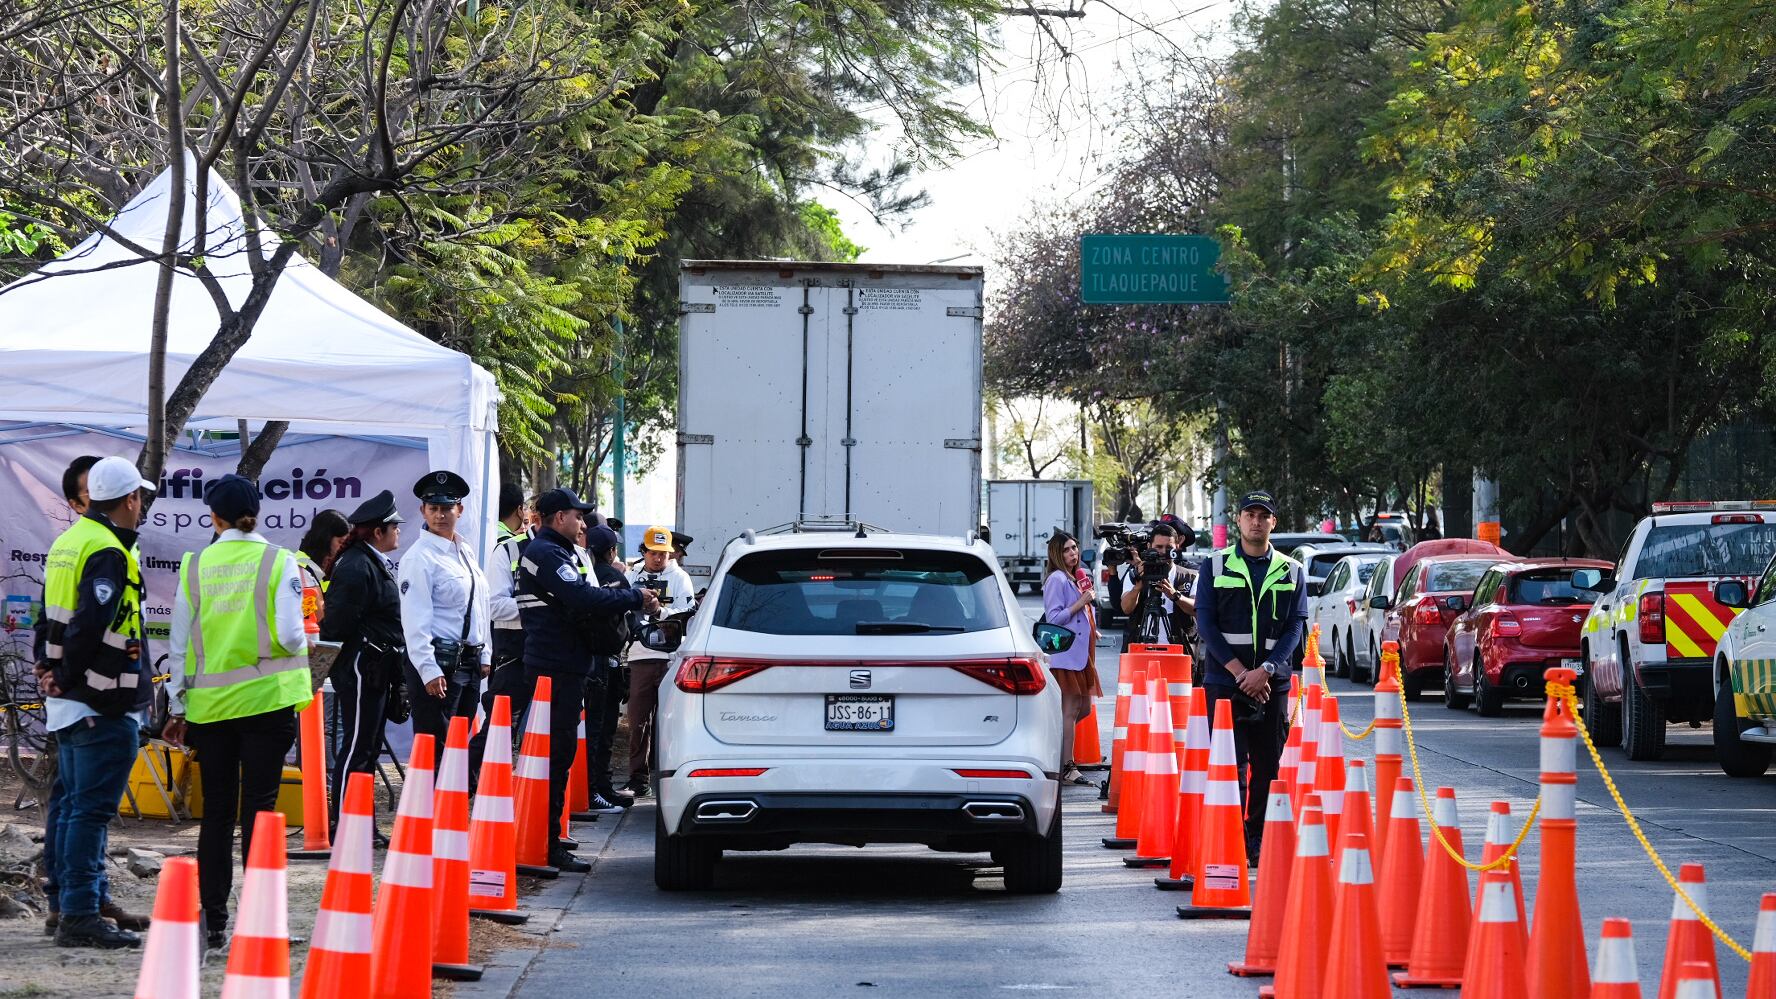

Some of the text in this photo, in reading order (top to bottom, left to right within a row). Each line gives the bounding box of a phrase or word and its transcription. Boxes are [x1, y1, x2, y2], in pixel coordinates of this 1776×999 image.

[1092, 247, 1199, 265] ZONA CENTRO
[1092, 273, 1199, 292] TLAQUEPAQUE
[1750, 531, 1762, 543] LA
[11, 549, 48, 566] Resp
[146, 556, 181, 573] limp
[829, 705, 891, 720] JSS-86-11
